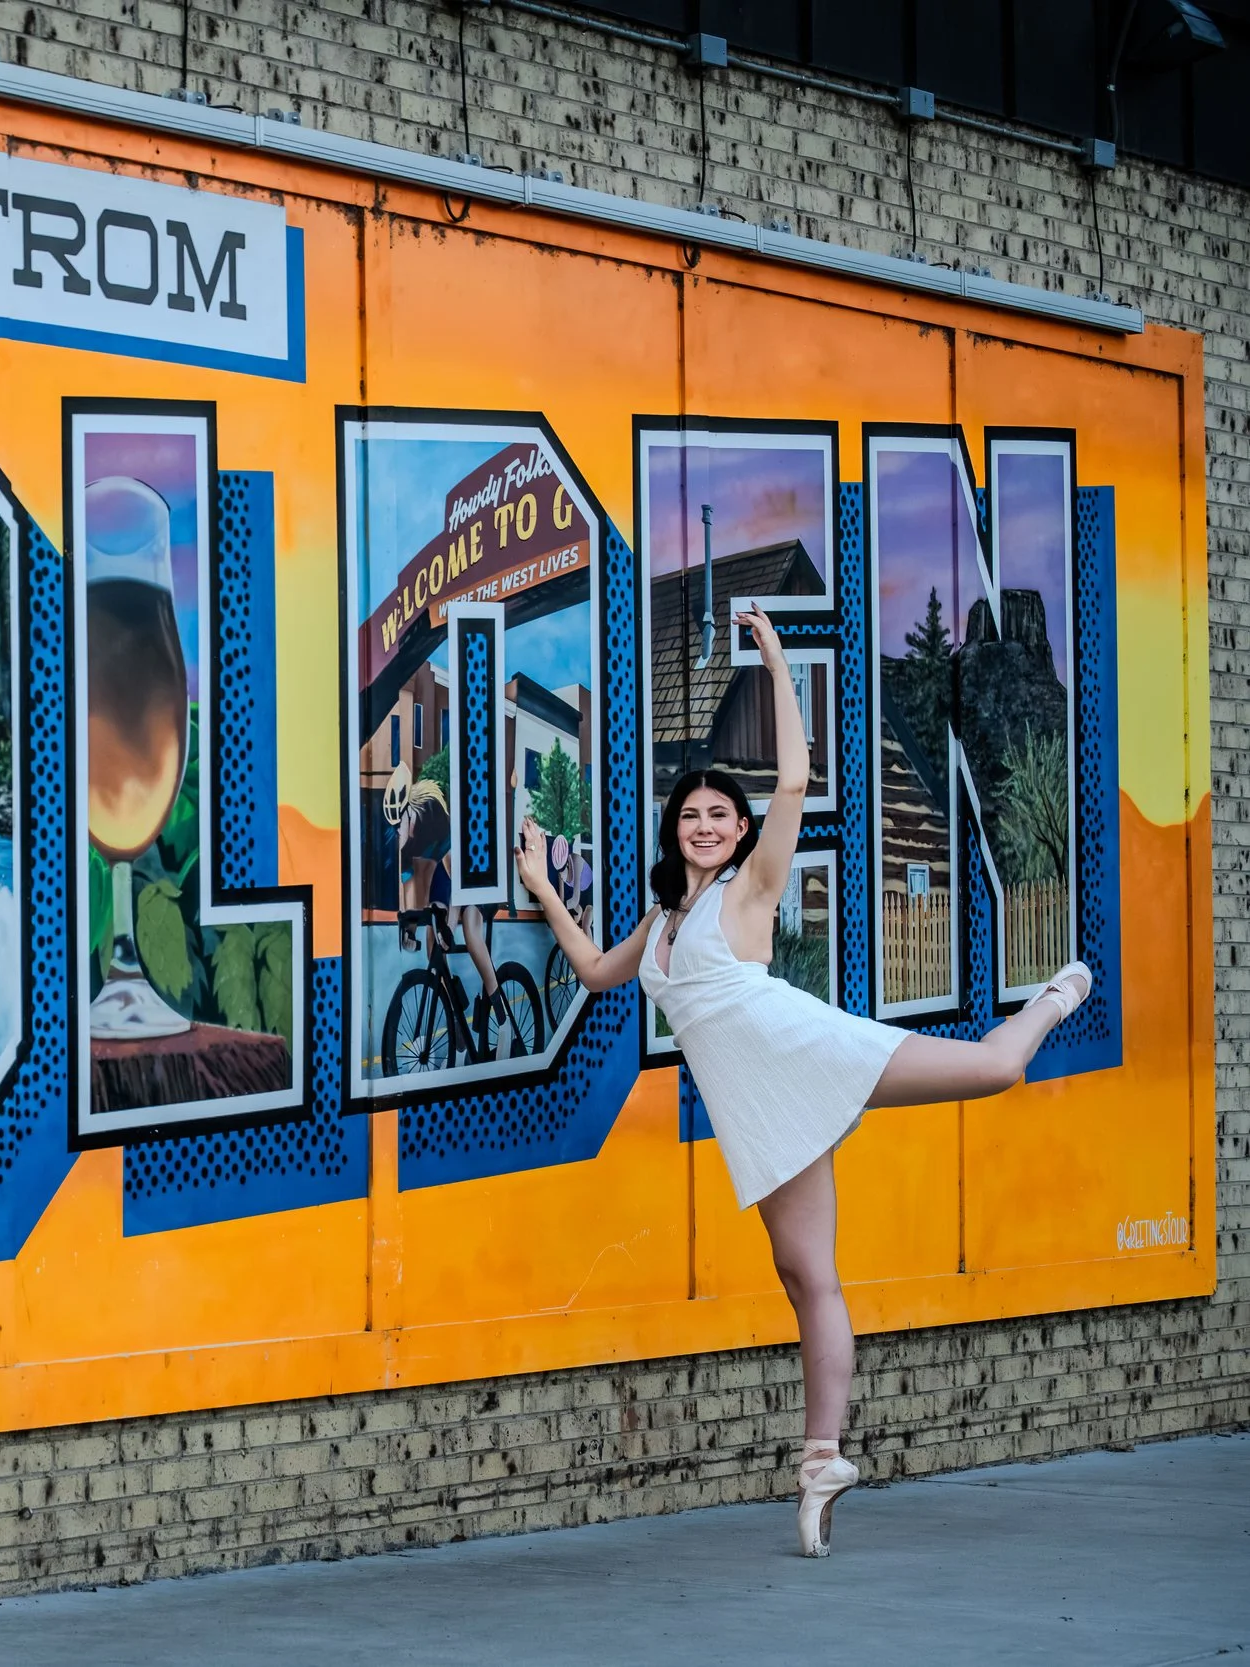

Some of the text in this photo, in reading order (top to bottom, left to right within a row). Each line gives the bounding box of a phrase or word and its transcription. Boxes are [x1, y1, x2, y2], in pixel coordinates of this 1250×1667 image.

[449, 473, 502, 534] Howdy
[494, 493, 538, 550] TO
[476, 580, 499, 602] THE
[501, 563, 538, 593] WEST
[539, 545, 579, 578] LIVES
